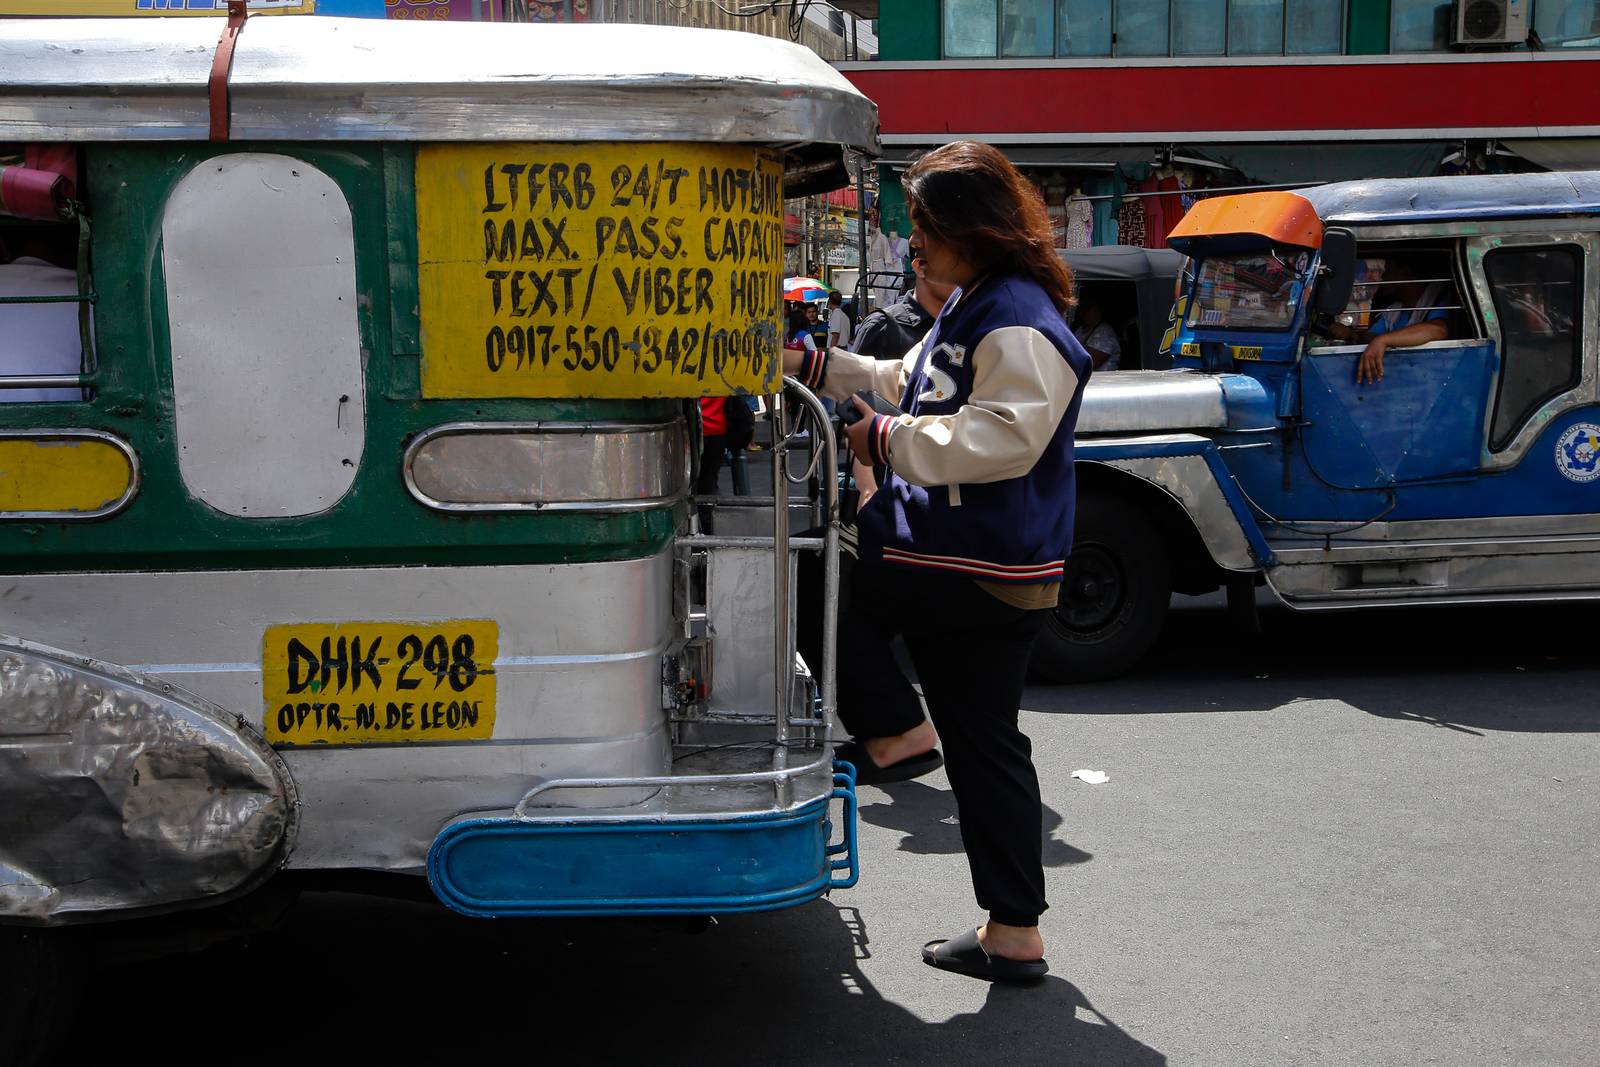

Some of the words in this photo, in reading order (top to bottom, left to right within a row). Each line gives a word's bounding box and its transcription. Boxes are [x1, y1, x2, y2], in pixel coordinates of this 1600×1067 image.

[482, 160, 596, 214] LTFRB
[483, 216, 580, 263] MAX.
[595, 216, 688, 262] PASS.
[612, 266, 714, 316] VIBER
[286, 633, 479, 695] DHK-298
[420, 700, 484, 731] LEON
